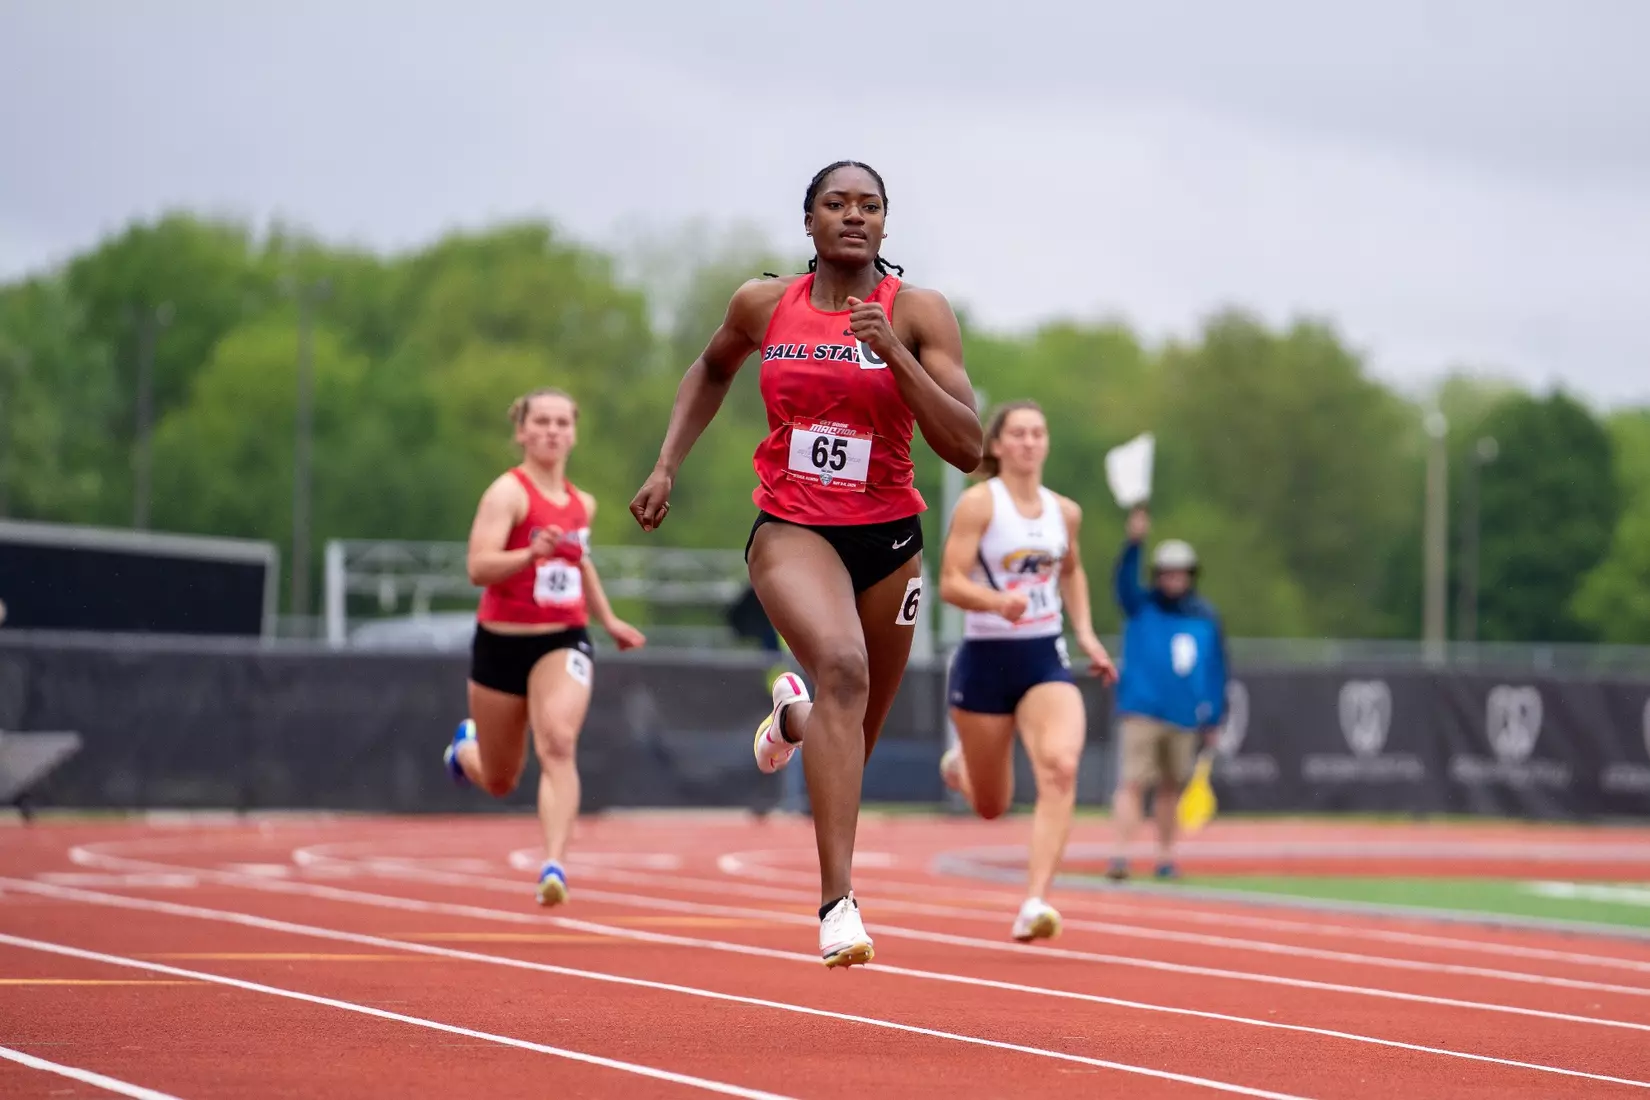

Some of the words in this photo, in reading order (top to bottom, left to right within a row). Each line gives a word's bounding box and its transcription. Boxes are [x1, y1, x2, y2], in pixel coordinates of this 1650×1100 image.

[764, 344, 808, 362] BALL
[811, 435, 848, 471] 65
[903, 587, 921, 621] 6
